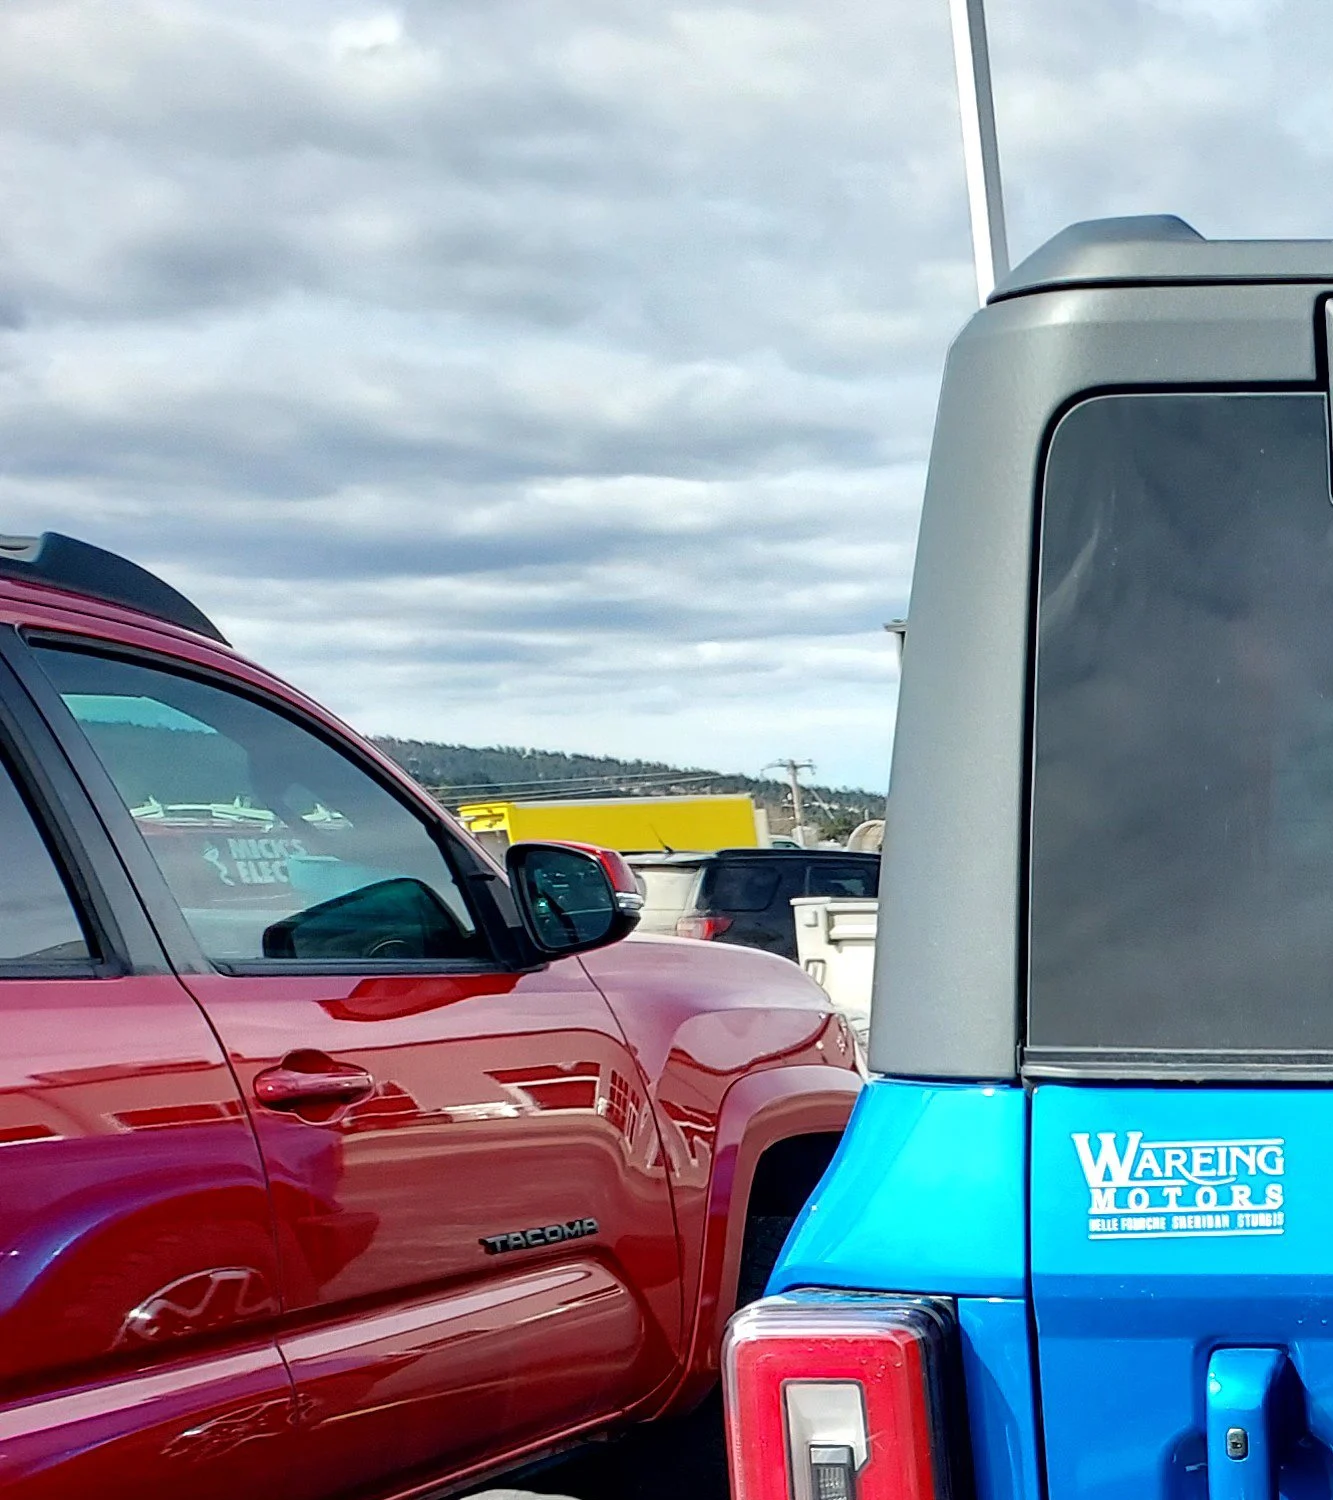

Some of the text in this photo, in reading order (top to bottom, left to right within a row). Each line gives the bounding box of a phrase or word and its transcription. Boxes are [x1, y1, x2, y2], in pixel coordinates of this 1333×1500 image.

[1071, 1130, 1285, 1188] WAREING
[1089, 1184, 1284, 1211] MOTORS
[484, 1217, 600, 1253] TACOMA
